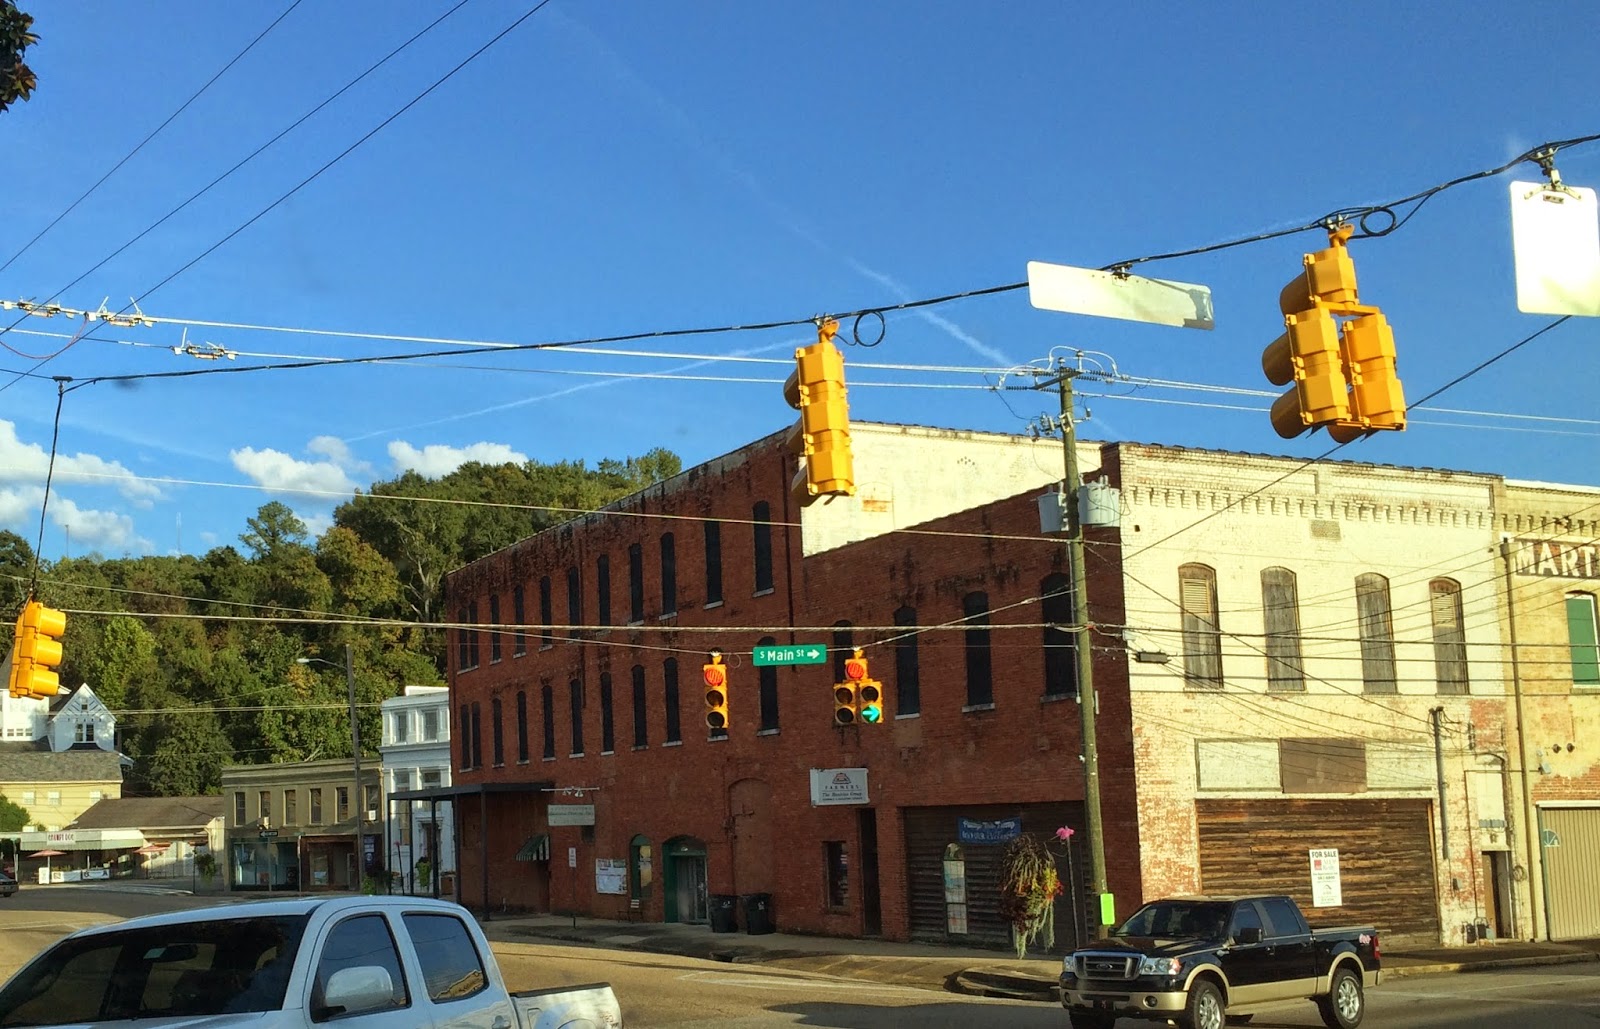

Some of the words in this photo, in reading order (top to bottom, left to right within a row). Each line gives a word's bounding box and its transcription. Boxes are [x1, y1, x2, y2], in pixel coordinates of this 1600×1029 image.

[760, 650, 765, 659] S
[767, 649, 794, 662] Main
[796, 649, 805, 658] St
